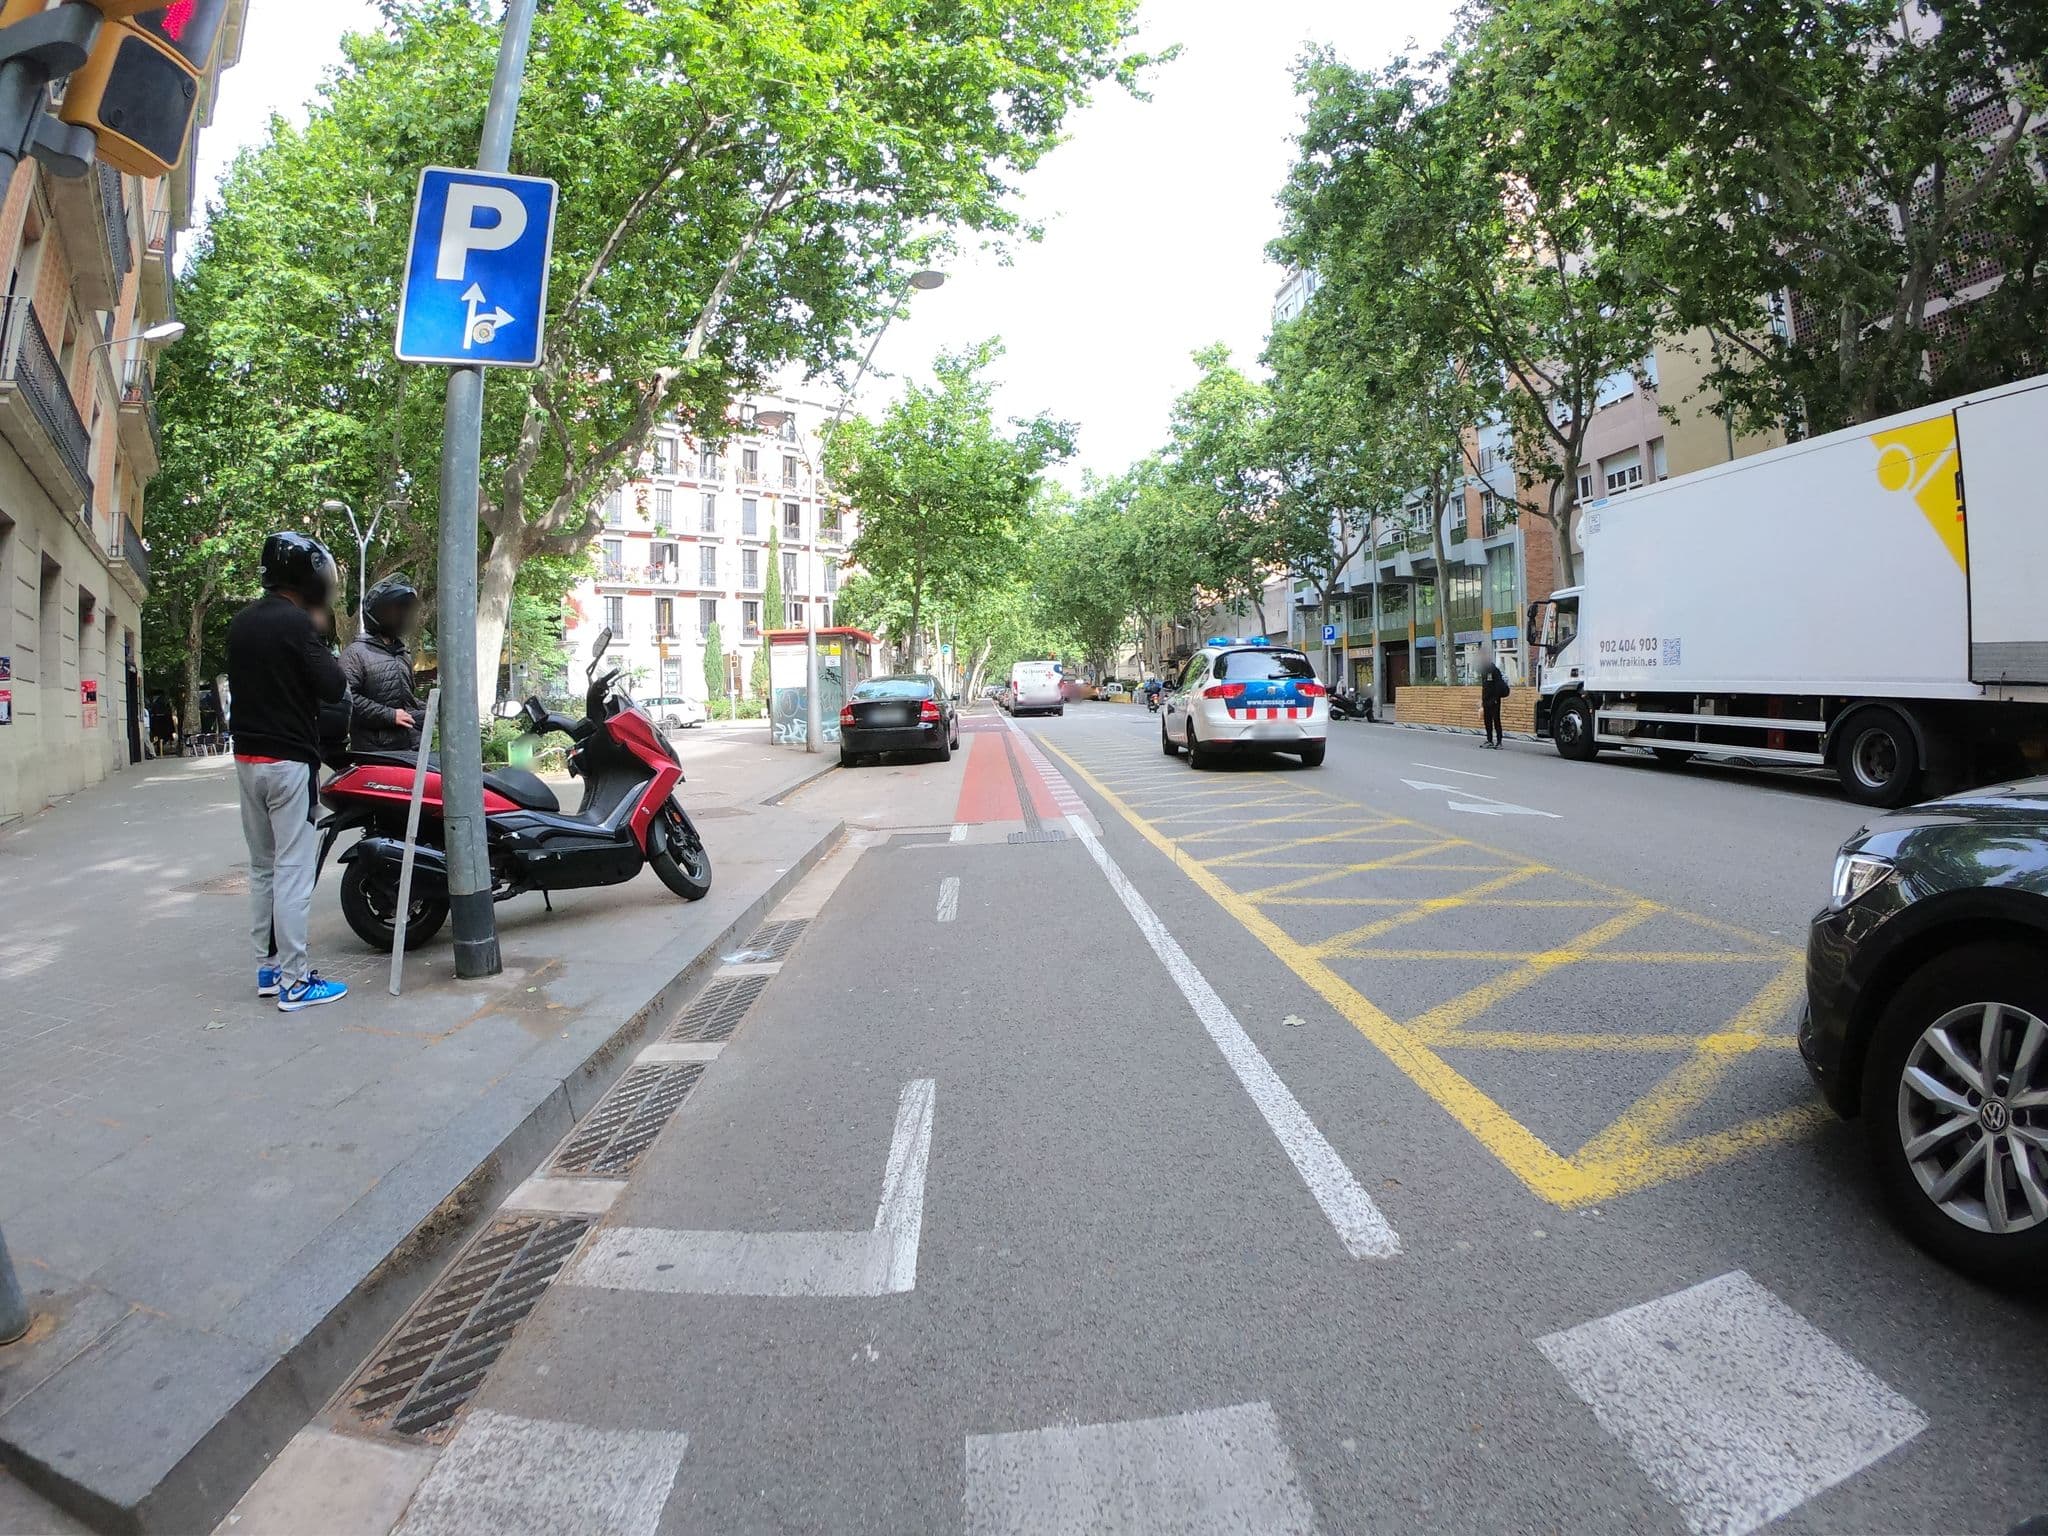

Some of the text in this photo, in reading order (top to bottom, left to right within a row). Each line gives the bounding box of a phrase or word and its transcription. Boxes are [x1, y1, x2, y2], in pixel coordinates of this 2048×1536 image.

[436, 183, 527, 280] P
[1325, 627, 1332, 638] P
[1600, 637, 1657, 652] 902 404 903
[1600, 656, 1656, 667] www.fraikin.es
